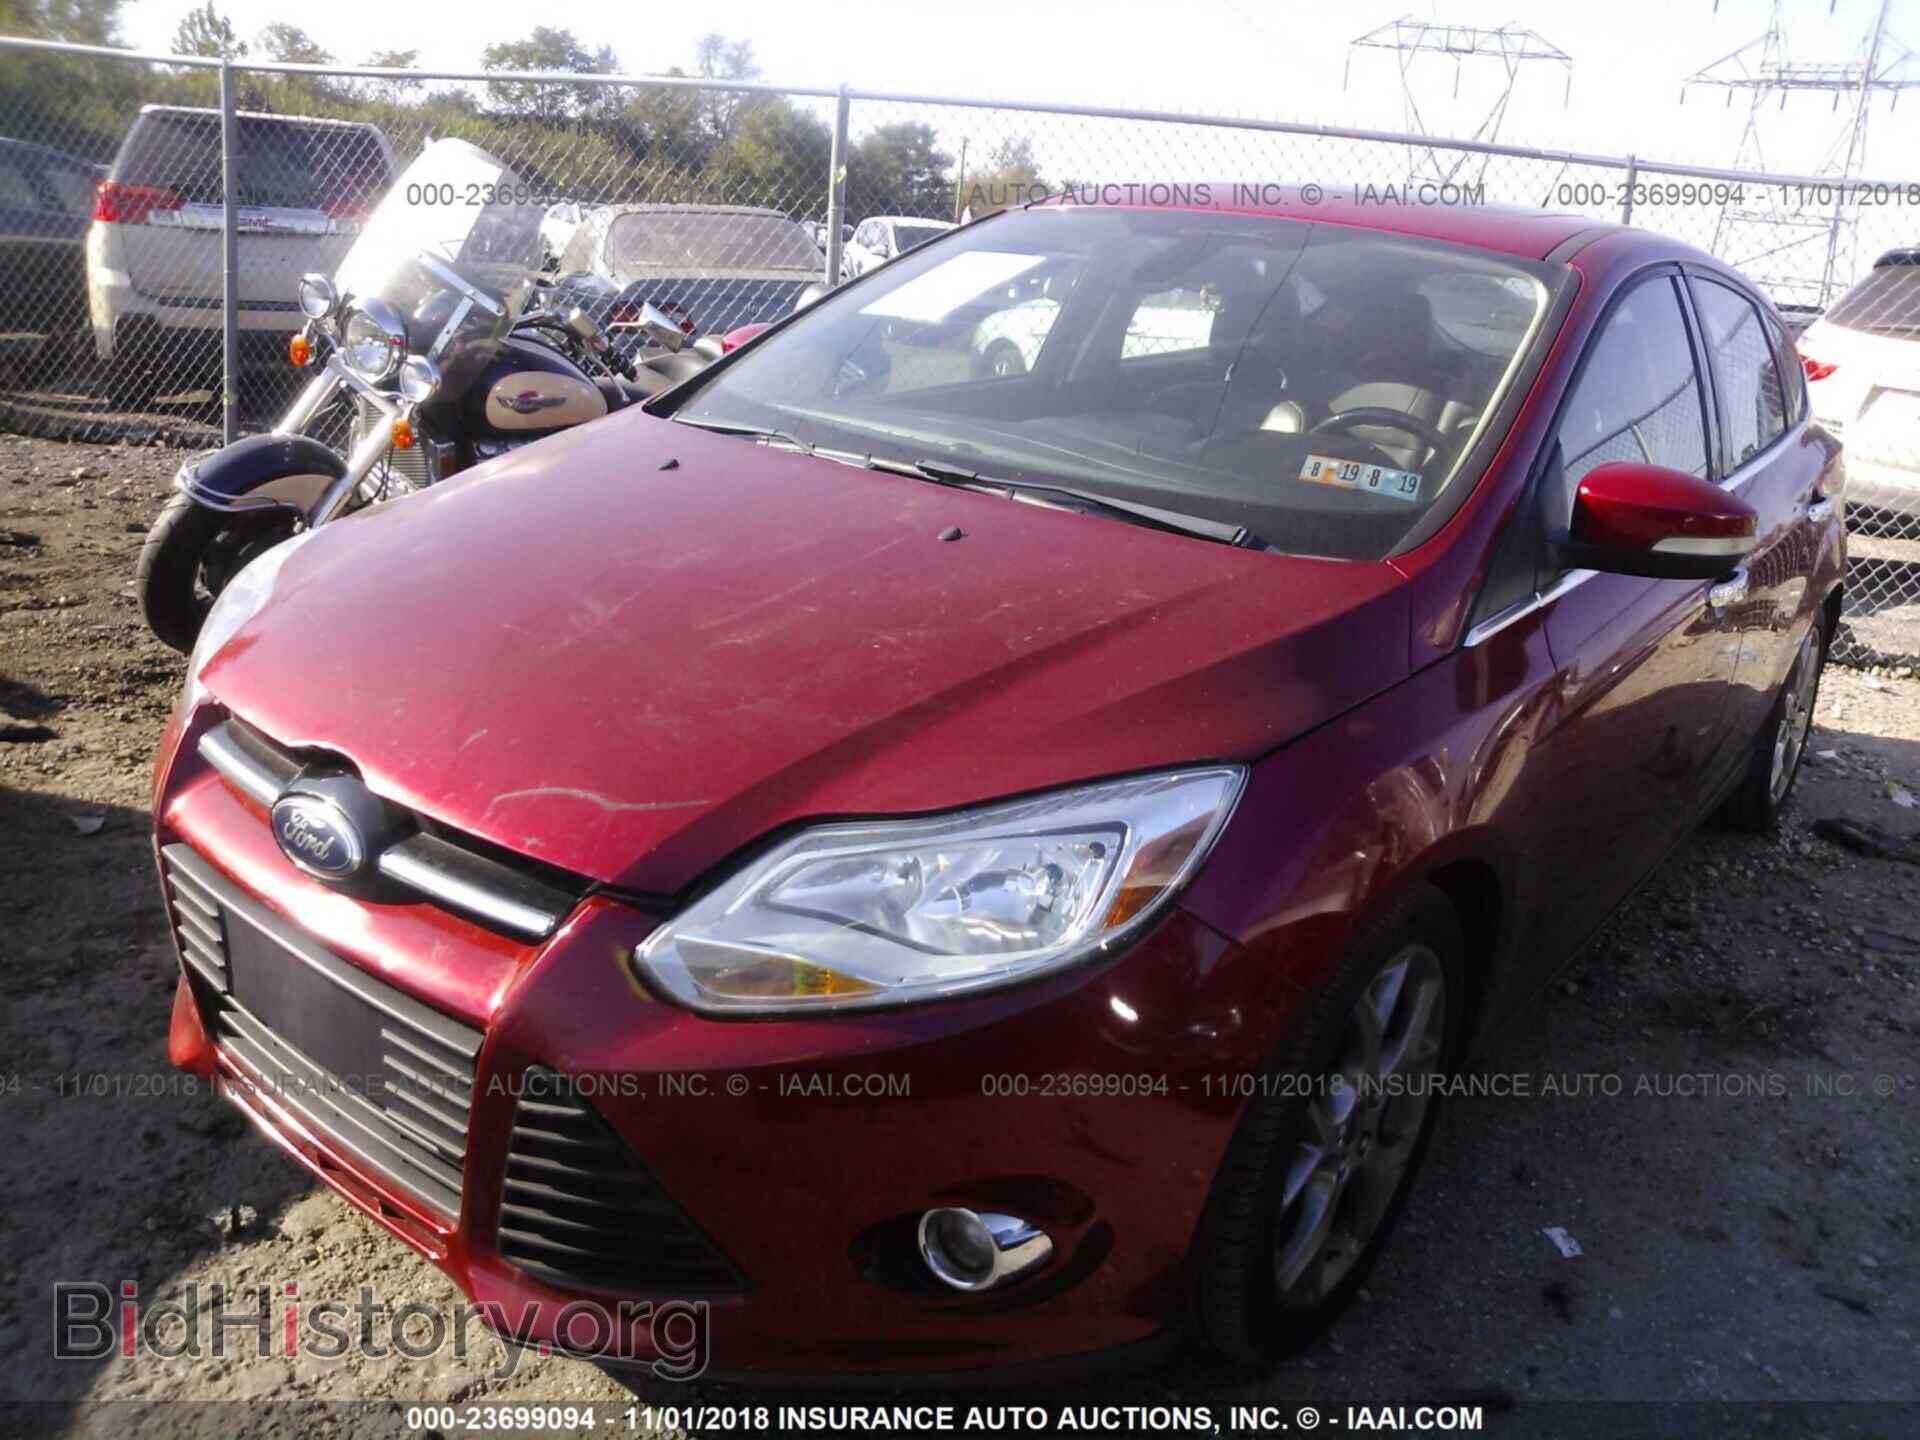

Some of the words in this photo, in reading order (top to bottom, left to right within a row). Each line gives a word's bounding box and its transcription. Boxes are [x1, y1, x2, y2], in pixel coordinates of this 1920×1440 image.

[1340, 463, 1360, 482] 19
[1398, 475, 1417, 494] 19
[283, 808, 336, 860] Ford
